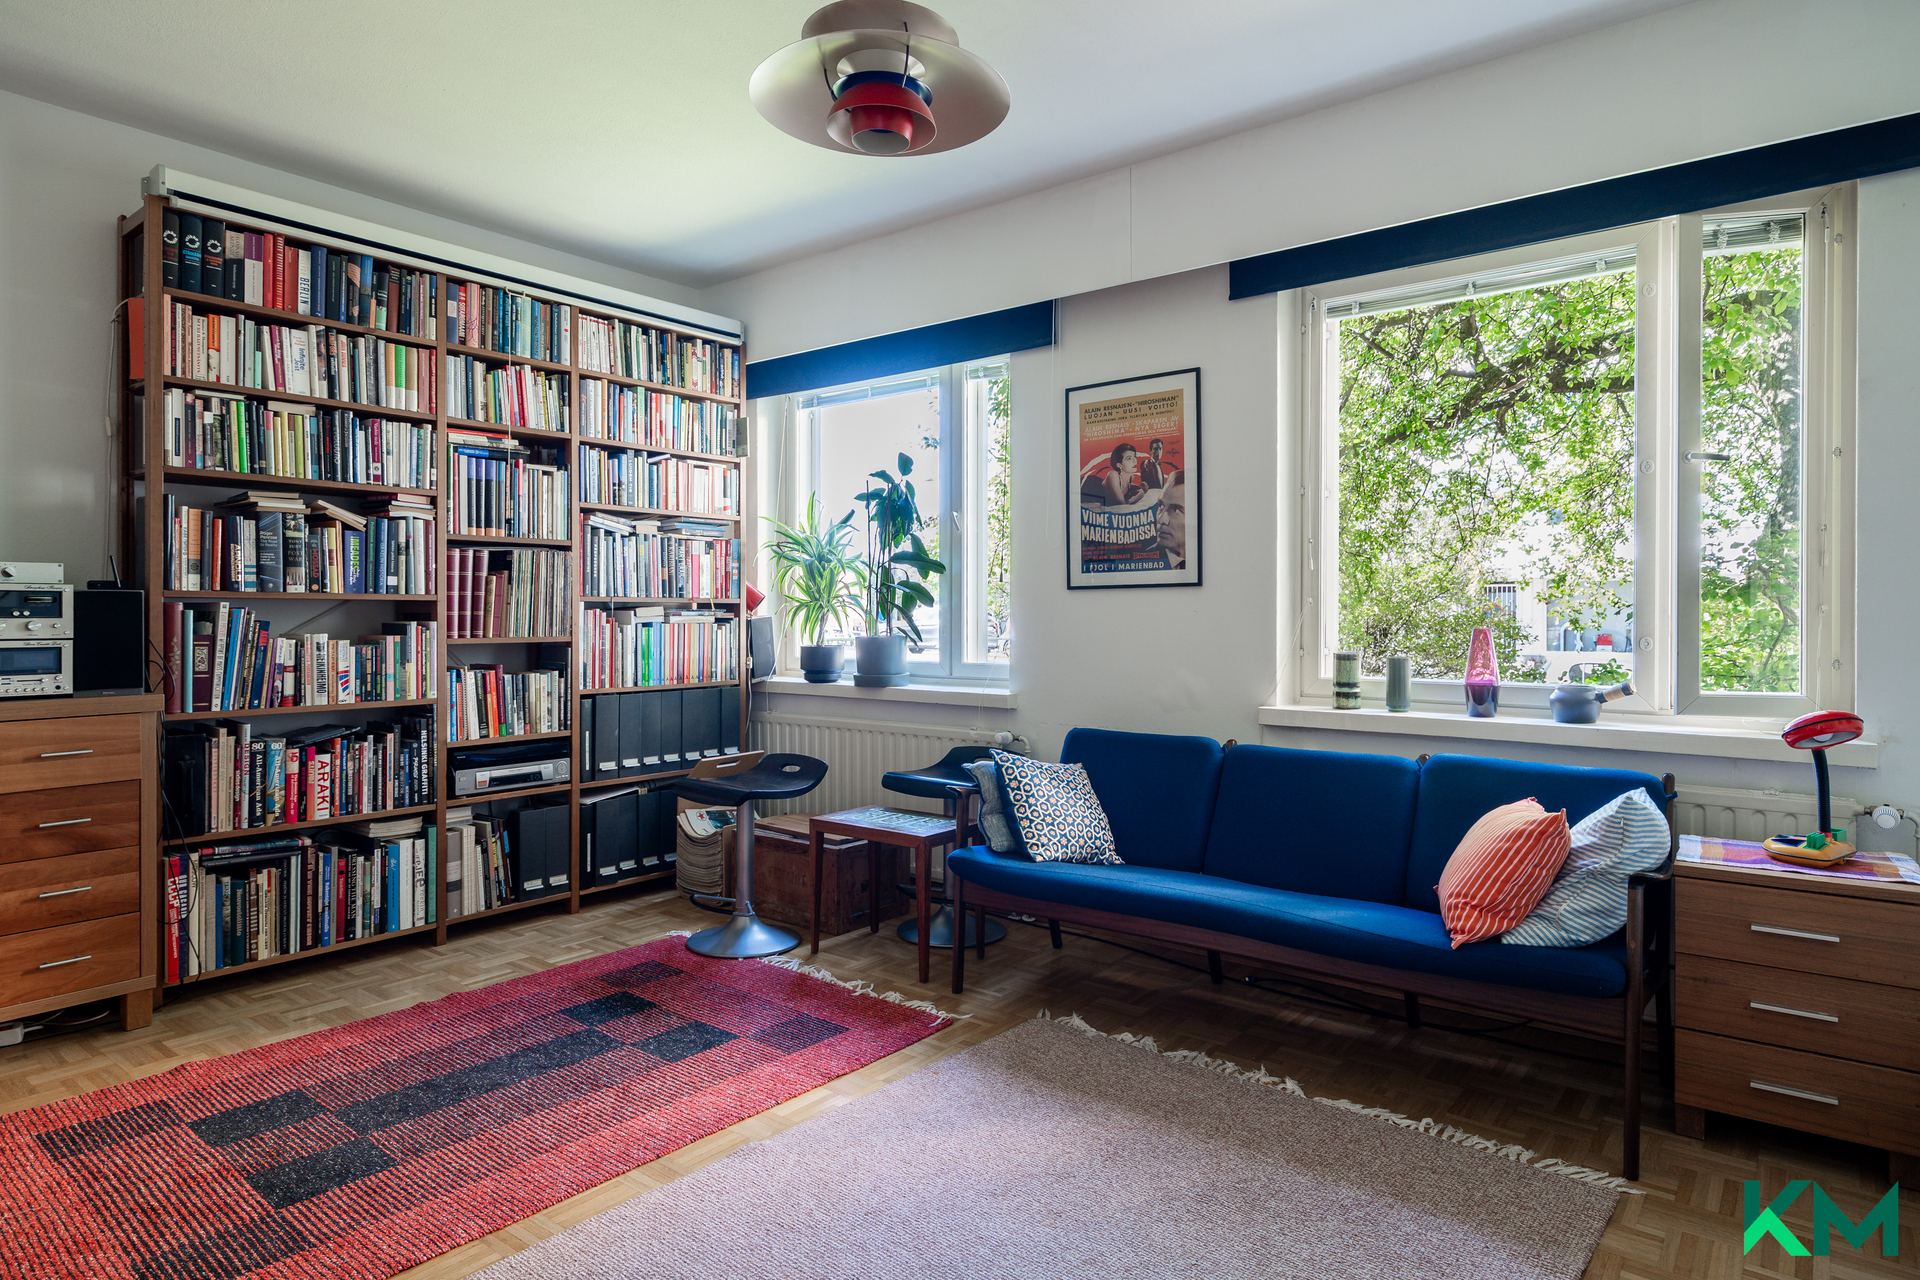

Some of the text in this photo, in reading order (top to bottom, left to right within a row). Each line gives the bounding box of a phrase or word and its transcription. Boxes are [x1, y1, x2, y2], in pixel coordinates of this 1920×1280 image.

[299, 277, 309, 305] BERLIN
[298, 347, 306, 371] Infinite
[1084, 411, 1113, 420] LUOJAN
[1148, 401, 1178, 410] VOITTO!
[1085, 425, 1102, 433] ALAIN
[1135, 417, 1167, 426] SKAPAREN
[1153, 421, 1178, 429] SEGER!
[1082, 509, 1154, 529] VIIME VUONNA
[1081, 523, 1156, 544] MARIENBADISSA
[1118, 561, 1164, 570] MARIENBAD
[258, 630, 269, 646] AKIRA
[216, 661, 224, 671] MASS
[214, 671, 223, 699] COMMUNICATION
[255, 754, 263, 801] All-American
[317, 760, 329, 812] ARAKI
[307, 847, 316, 871] ART
[178, 874, 188, 887] OUR
[167, 876, 180, 907] CCCP
